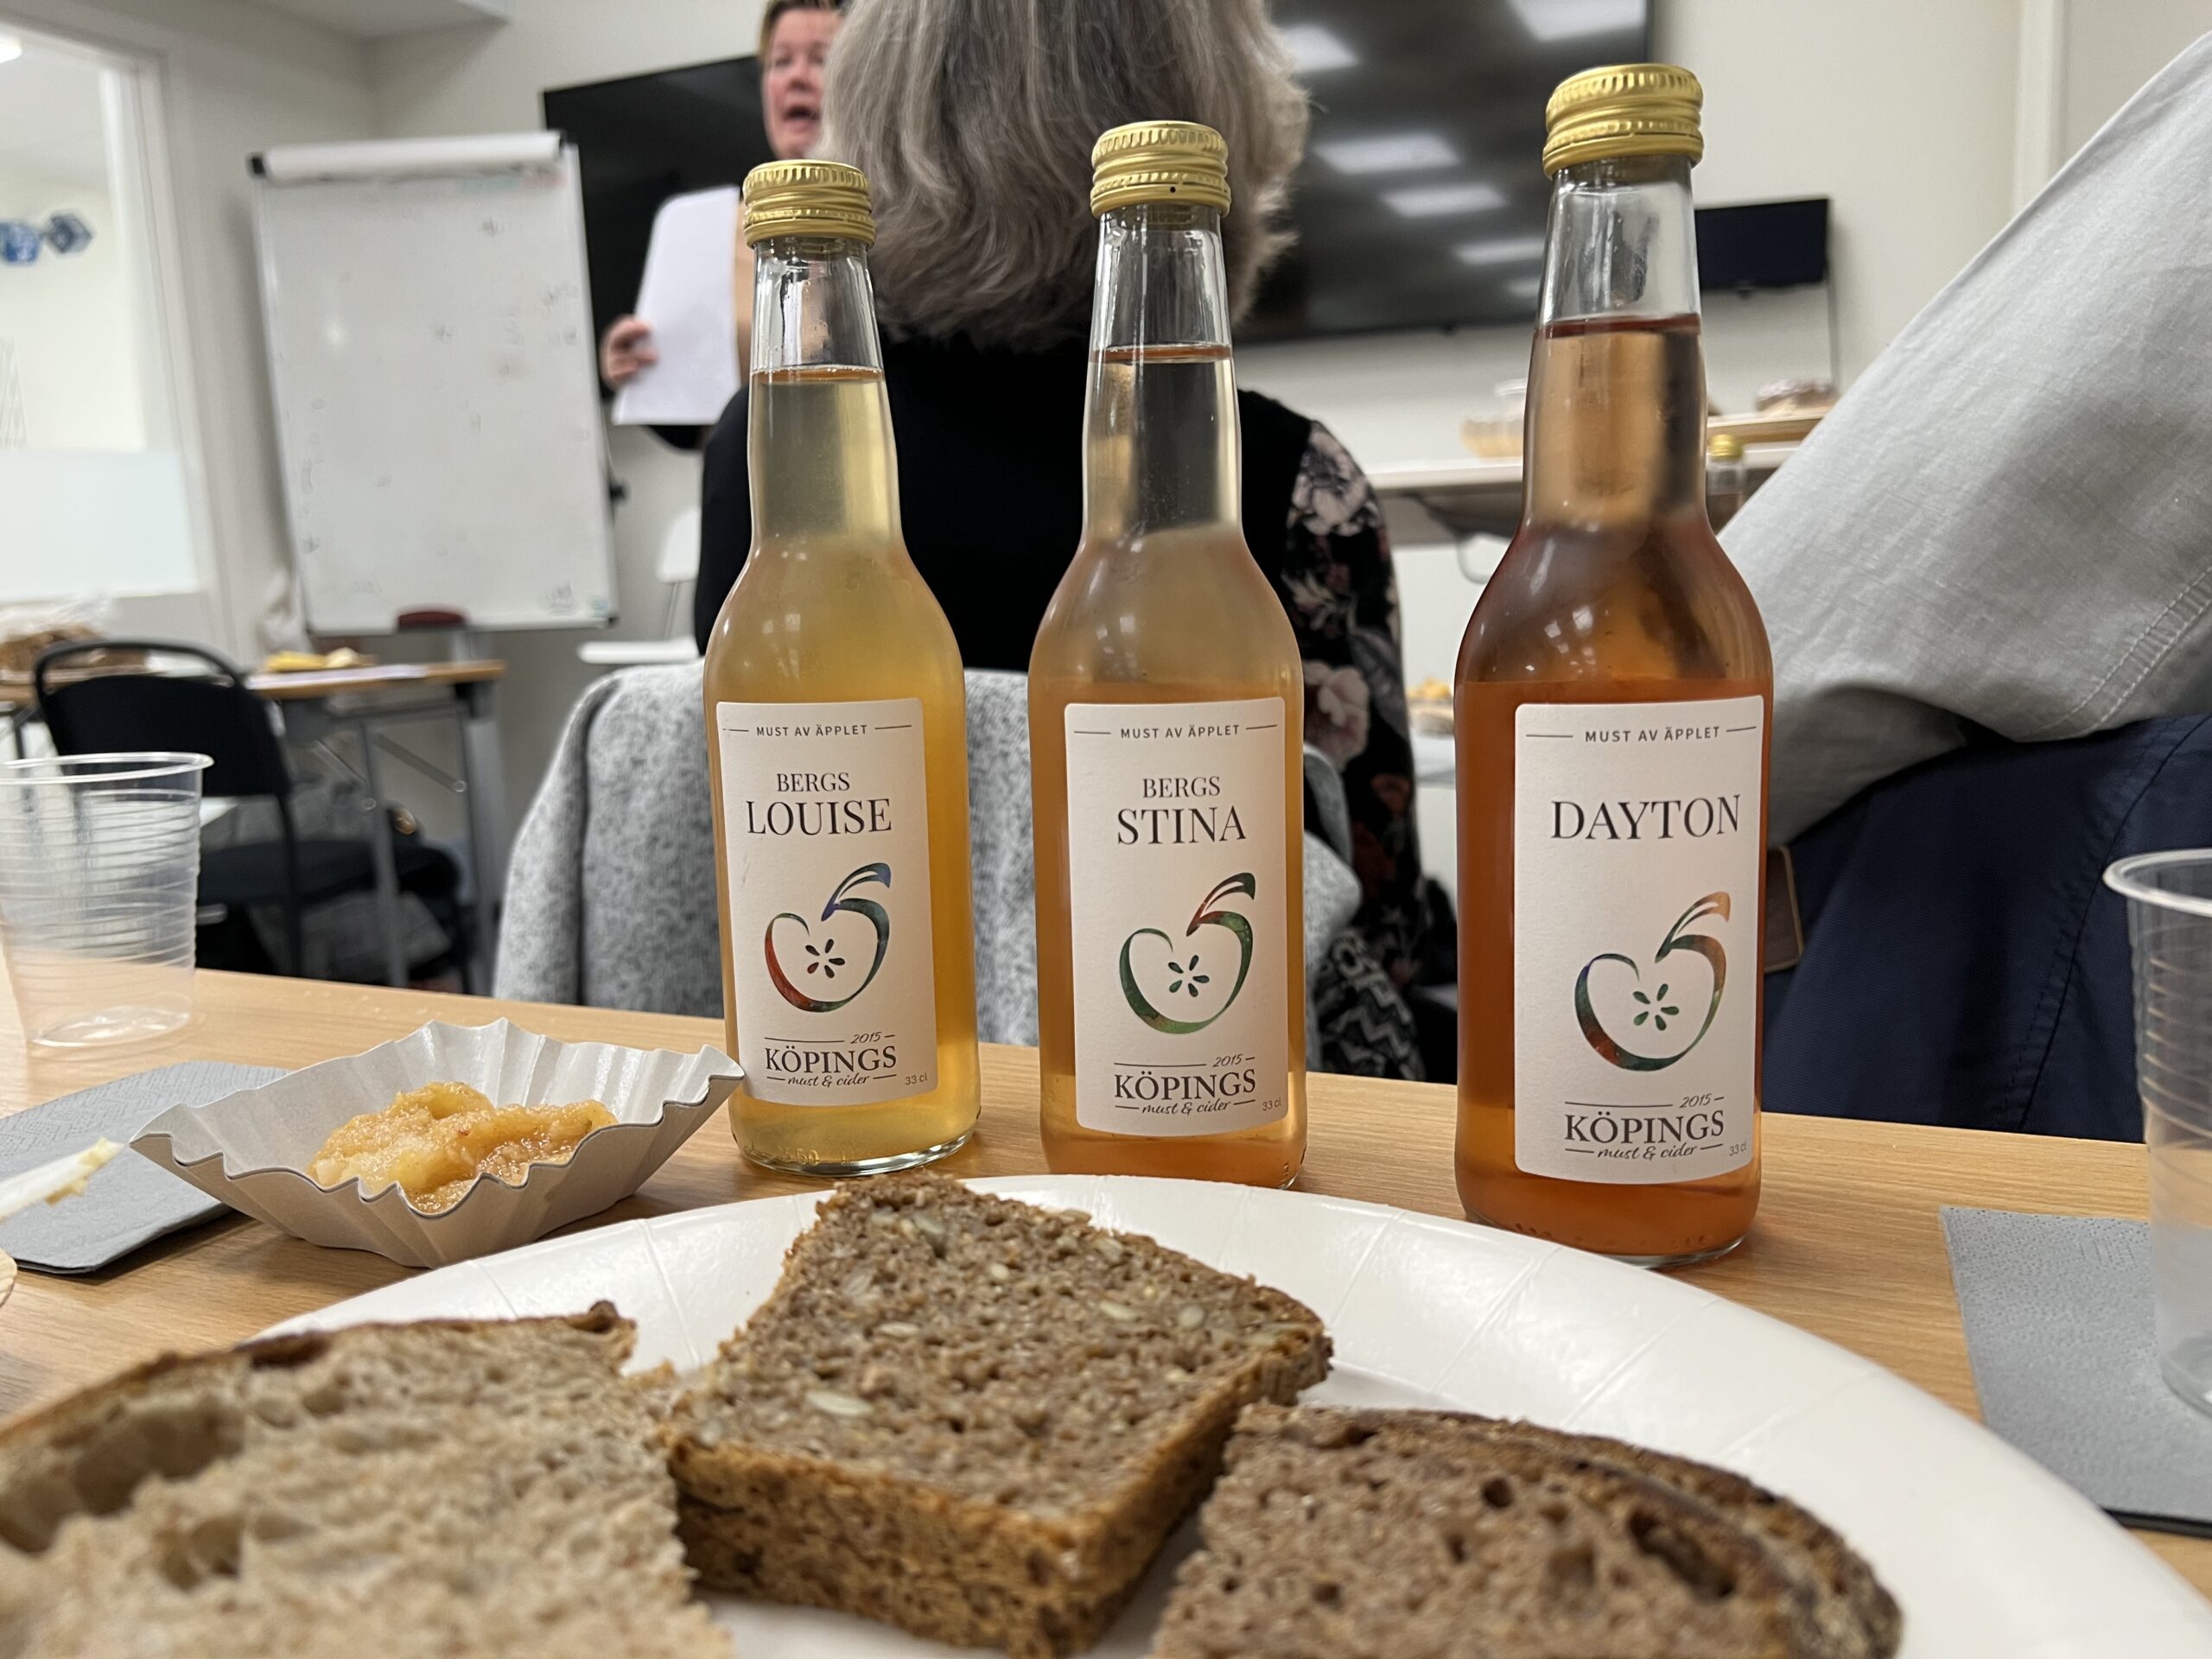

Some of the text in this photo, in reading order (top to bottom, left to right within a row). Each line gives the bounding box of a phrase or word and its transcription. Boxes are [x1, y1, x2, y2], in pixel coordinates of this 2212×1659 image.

[756, 724, 868, 737] MUST AV ÄPPLET
[1121, 724, 1240, 740] MUST AV ÄPPLET
[1585, 726, 1719, 743] MUST AV ÄPPLET
[777, 772, 850, 792] BERGS
[1142, 776, 1221, 798] BERGS
[746, 798, 892, 836] LOUISE
[1117, 805, 1247, 845] STINA
[1551, 794, 1740, 840] DAYTON
[849, 1031, 882, 1045] 2015
[765, 1045, 898, 1075] KÖPINGS
[1211, 1053, 1243, 1068] 2015
[787, 1072, 870, 1089] must & cider
[905, 1072, 928, 1086] 33 cl
[1114, 1068, 1256, 1100] KÖPINGS
[1141, 1099, 1231, 1116] must & cider
[1262, 1096, 1281, 1112] 33 cl
[1679, 1093, 1713, 1109] 2015
[1564, 1109, 1725, 1145] KÖPINGS
[1597, 1143, 1698, 1161] must & cider
[1728, 1141, 1747, 1157] 33 cl
